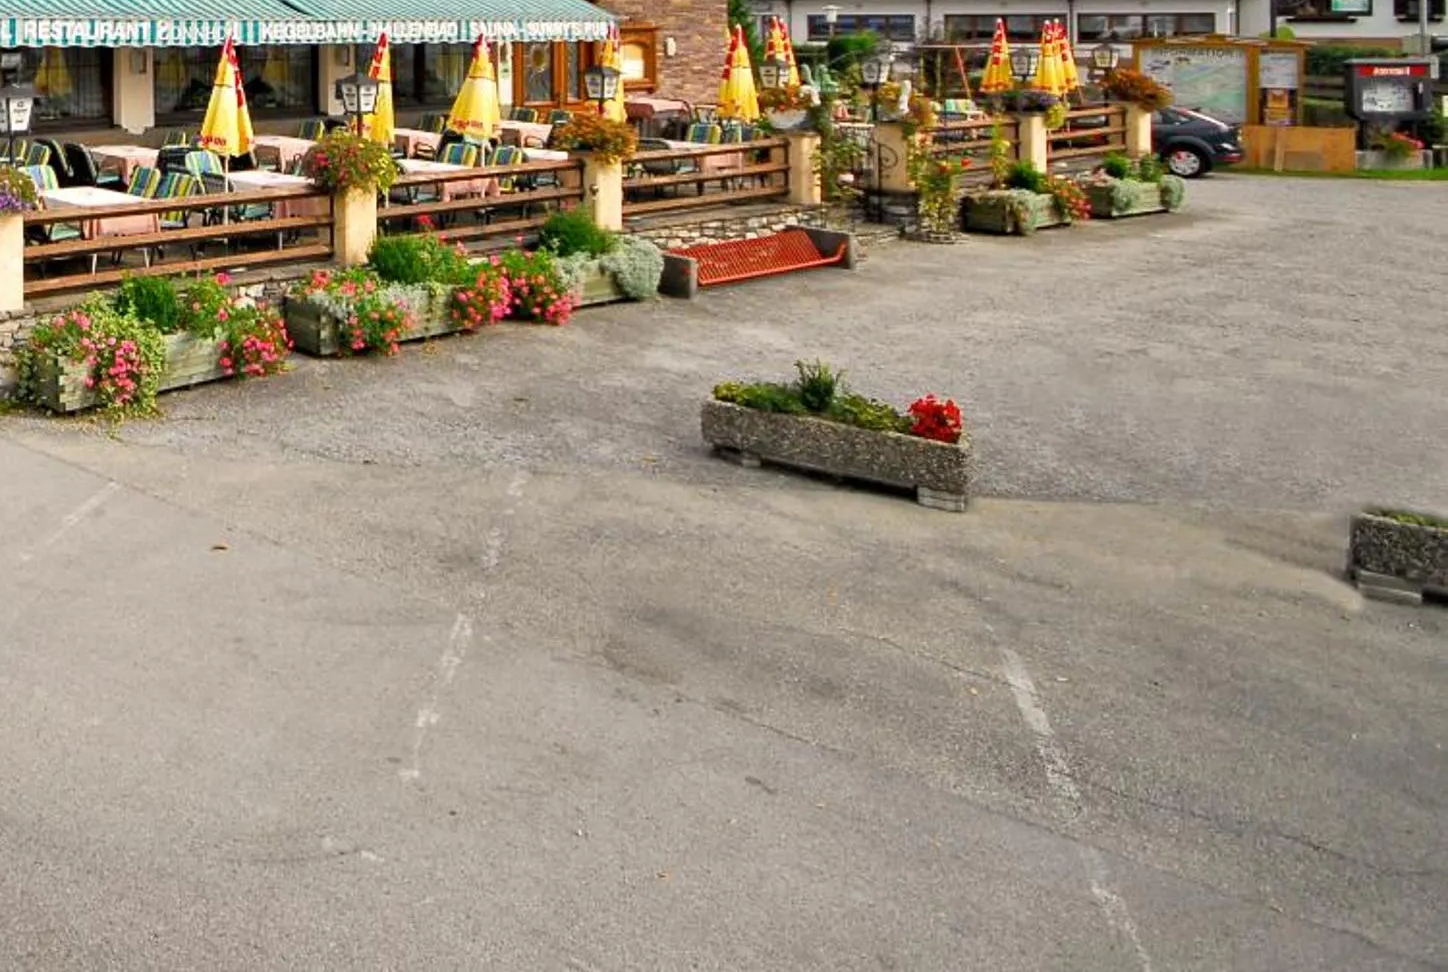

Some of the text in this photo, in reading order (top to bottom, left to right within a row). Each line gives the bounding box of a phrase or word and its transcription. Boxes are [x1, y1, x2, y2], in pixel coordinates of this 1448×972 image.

[23, 18, 149, 41] RESTAURANT
[262, 20, 359, 41] KEGELBAHN
[470, 21, 515, 39] SAUNA
